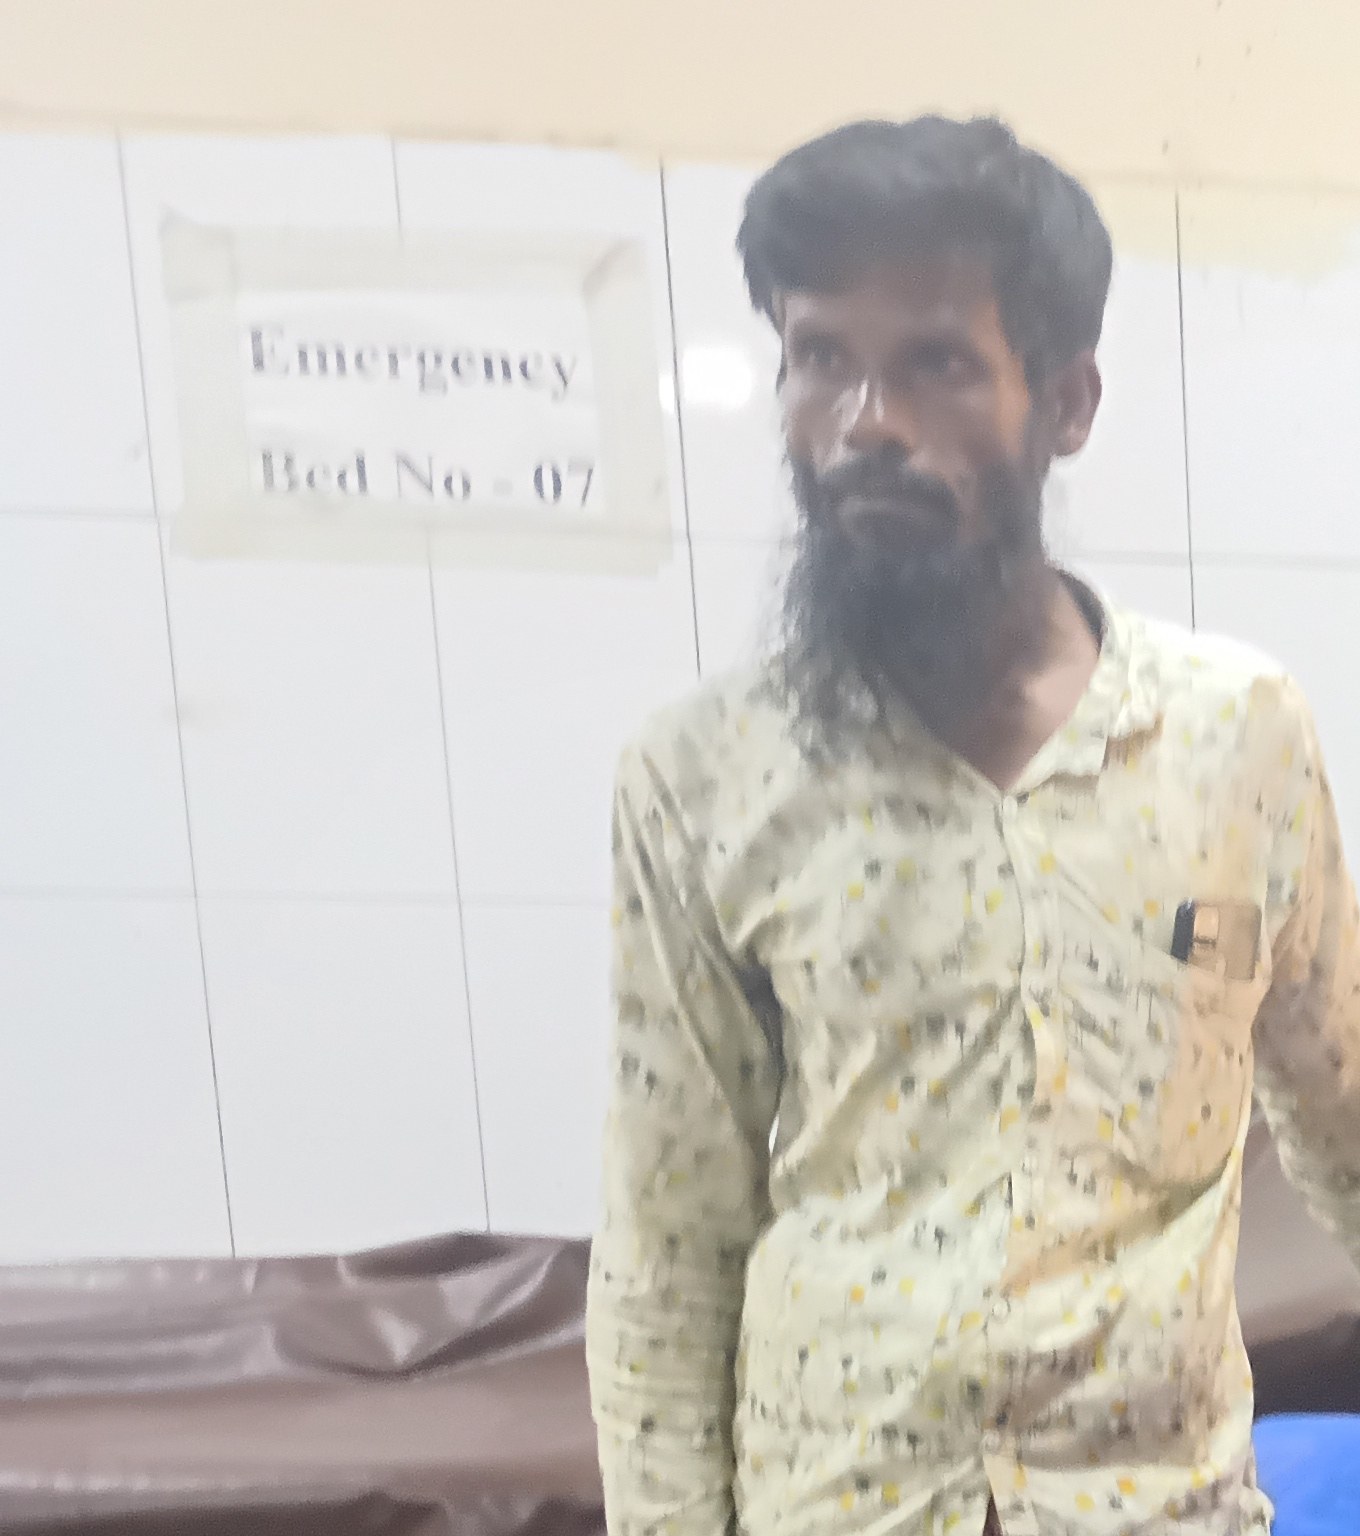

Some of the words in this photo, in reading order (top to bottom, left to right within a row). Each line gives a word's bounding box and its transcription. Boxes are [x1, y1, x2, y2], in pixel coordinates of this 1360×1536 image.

[250, 326, 577, 400] Emergency
[261, 448, 369, 495] Bed
[394, 454, 472, 501] No
[532, 458, 596, 508] 07
